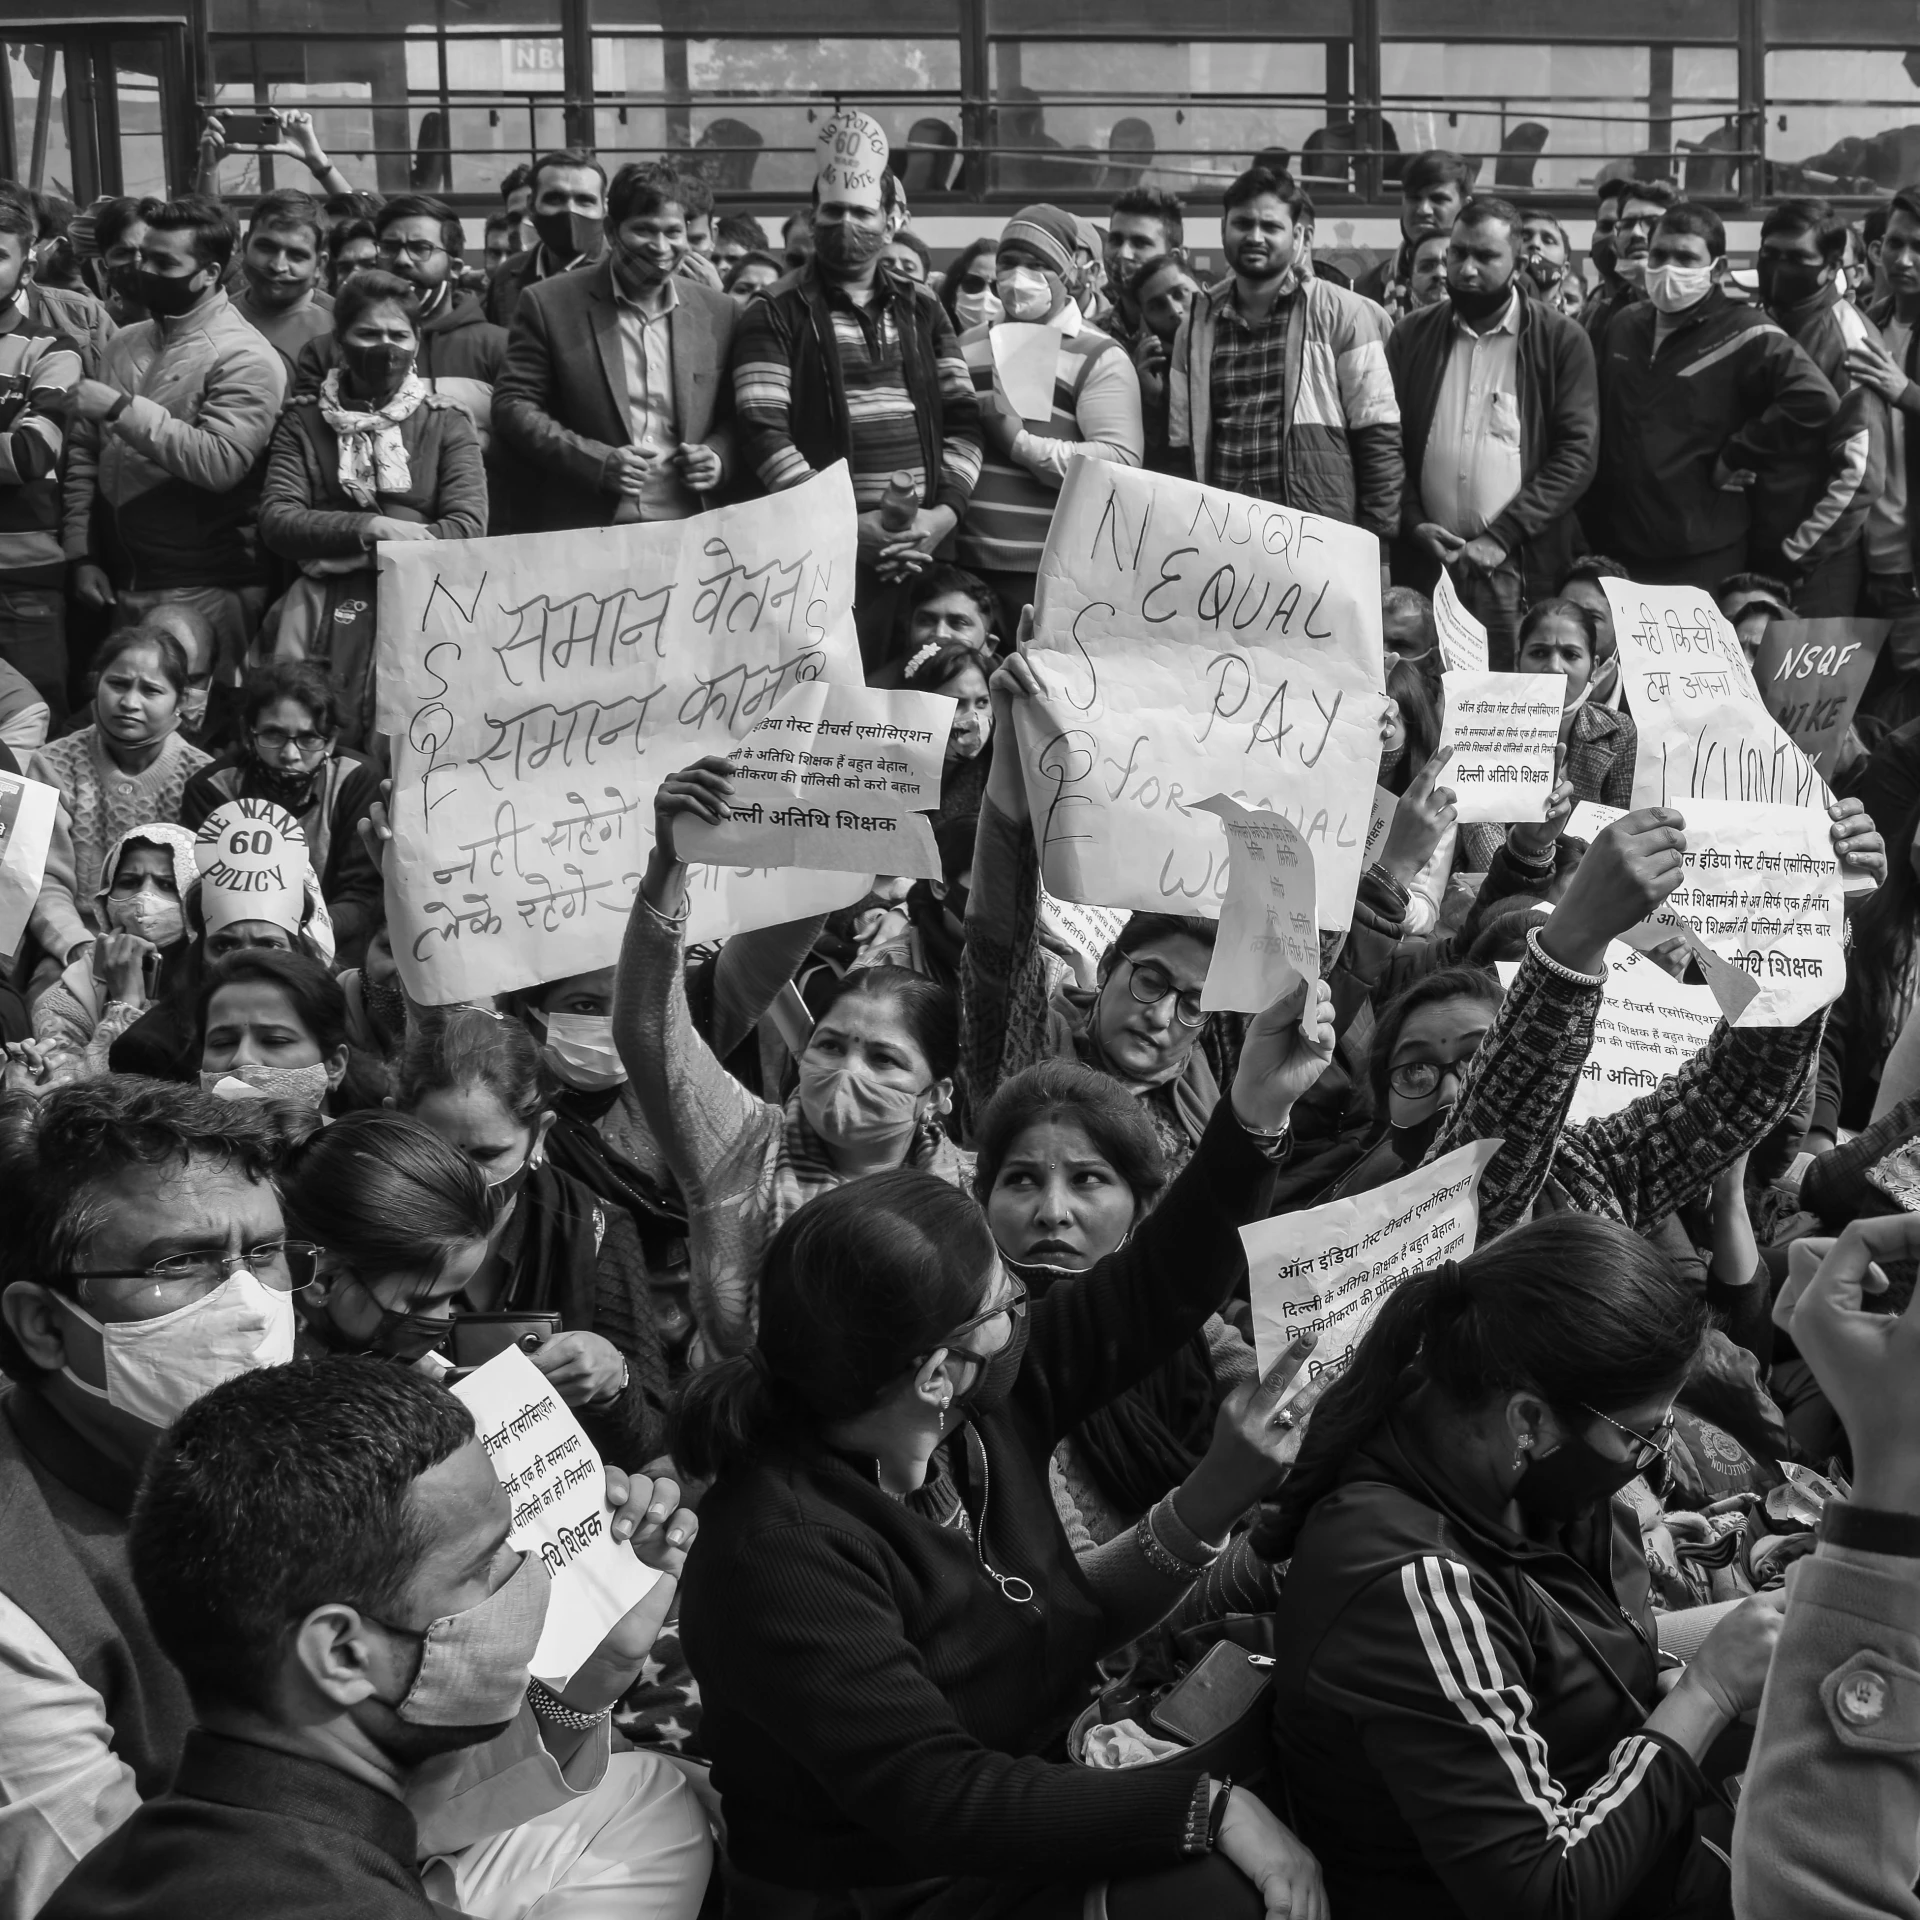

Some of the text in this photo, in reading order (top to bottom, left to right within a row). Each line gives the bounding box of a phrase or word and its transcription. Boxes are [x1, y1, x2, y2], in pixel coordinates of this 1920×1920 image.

[836, 131, 861, 156] 60
[841, 111, 885, 157] POLICY
[1188, 493, 1323, 574] NSQF
[1142, 547, 1332, 638] EQUAL
[493, 537, 813, 686] समान वेतन
[1774, 641, 1862, 681] NSQF
[1194, 653, 1344, 768] PAY
[1476, 700, 1496, 714] इंडिया
[468, 684, 668, 791] समान
[786, 715, 814, 735] गेस्ट
[816, 720, 854, 738] टीचर्स
[856, 722, 934, 745] एसोसिएशन
[743, 747, 755, 760] के
[756, 748, 796, 764] अतिथि
[798, 751, 834, 769] शिक्षक
[836, 754, 847, 770] हैं
[847, 758, 873, 774] बहुत
[1456, 764, 1550, 784] दिल्ली अतिथि शिक्षक
[780, 769, 798, 785] की
[800, 770, 841, 789] पॉलिसी
[843, 773, 860, 790] को
[863, 776, 888, 793] करो
[890, 781, 921, 796] बहाल
[195, 798, 309, 847] WE WANT
[769, 806, 832, 829] अतिथि
[835, 810, 898, 832] शिक्षक
[229, 830, 273, 855] 60
[201, 858, 288, 892] POLICY
[1699, 848, 1731, 870] इंडिया
[1734, 849, 1754, 871] गेस्ट
[1756, 851, 1782, 873] टीचर्स
[1783, 853, 1837, 878] एसोसिएशन
[1692, 888, 1739, 910] शिक्षामंत्री
[1740, 890, 1749, 909] से
[1762, 891, 1783, 910] सिर्फ
[1784, 897, 1800, 914] एक
[1800, 894, 1812, 914] ही
[1061, 916, 1087, 945] अतिथि
[1706, 916, 1738, 935] शिक्षकों
[1751, 917, 1782, 936] पॉलिसी
[1797, 922, 1813, 939] इस
[1815, 924, 1832, 938] बार
[1768, 949, 1823, 980] शिक्षक
[1622, 998, 1656, 1015] टीचर्स
[1609, 1036, 1623, 1049] की
[1626, 1038, 1662, 1055] पॉलिसी
[1665, 1043, 1679, 1057] को
[1617, 1022, 1650, 1039] शिक्षक
[1662, 1031, 1685, 1044] बहुत
[1606, 1067, 1659, 1090] अतिथि
[1278, 1174, 1474, 1280] ऑल इंडिया गेस्ट टीचर्स एसोसिएशन
[1282, 1293, 1323, 1319] दिल्ली
[1324, 1288, 1335, 1305] के
[1336, 1270, 1371, 1297] अतिथि
[1372, 1252, 1399, 1280] शिक्षक
[1400, 1241, 1409, 1262] हैं
[1409, 1234, 1430, 1255] बहुत
[1360, 1288, 1373, 1307] की
[1426, 1246, 1442, 1268] करो
[1443, 1233, 1466, 1258] बहाल
[509, 1396, 557, 1442] एसोसिएशन
[519, 1465, 535, 1490] एक
[533, 1454, 547, 1480] ही
[545, 1434, 583, 1467] समाधान
[513, 1459, 597, 1530] पॉलिसी का हो निर्माण
[557, 1510, 604, 1562] शिक्षक
